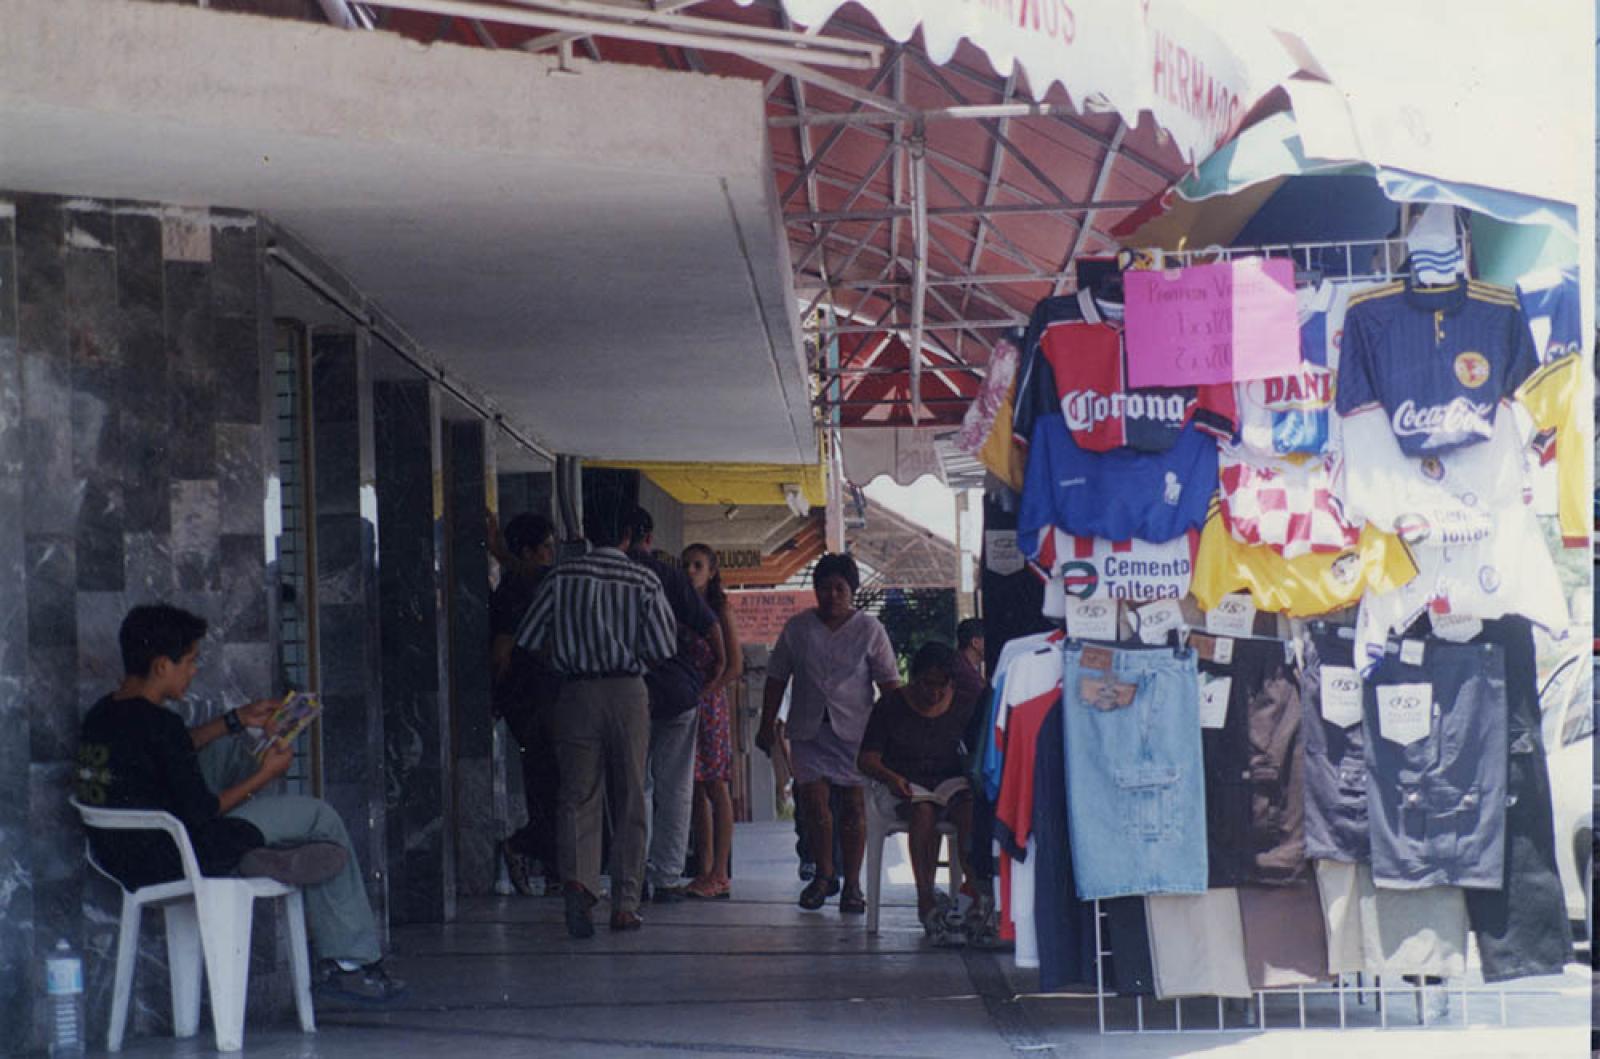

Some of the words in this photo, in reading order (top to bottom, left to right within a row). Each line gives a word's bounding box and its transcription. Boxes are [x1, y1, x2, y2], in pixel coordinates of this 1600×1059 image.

[1061, 390, 1185, 432] Corona
[1104, 556, 1189, 577] Cemento
[1105, 581, 1180, 599] Tolteca
